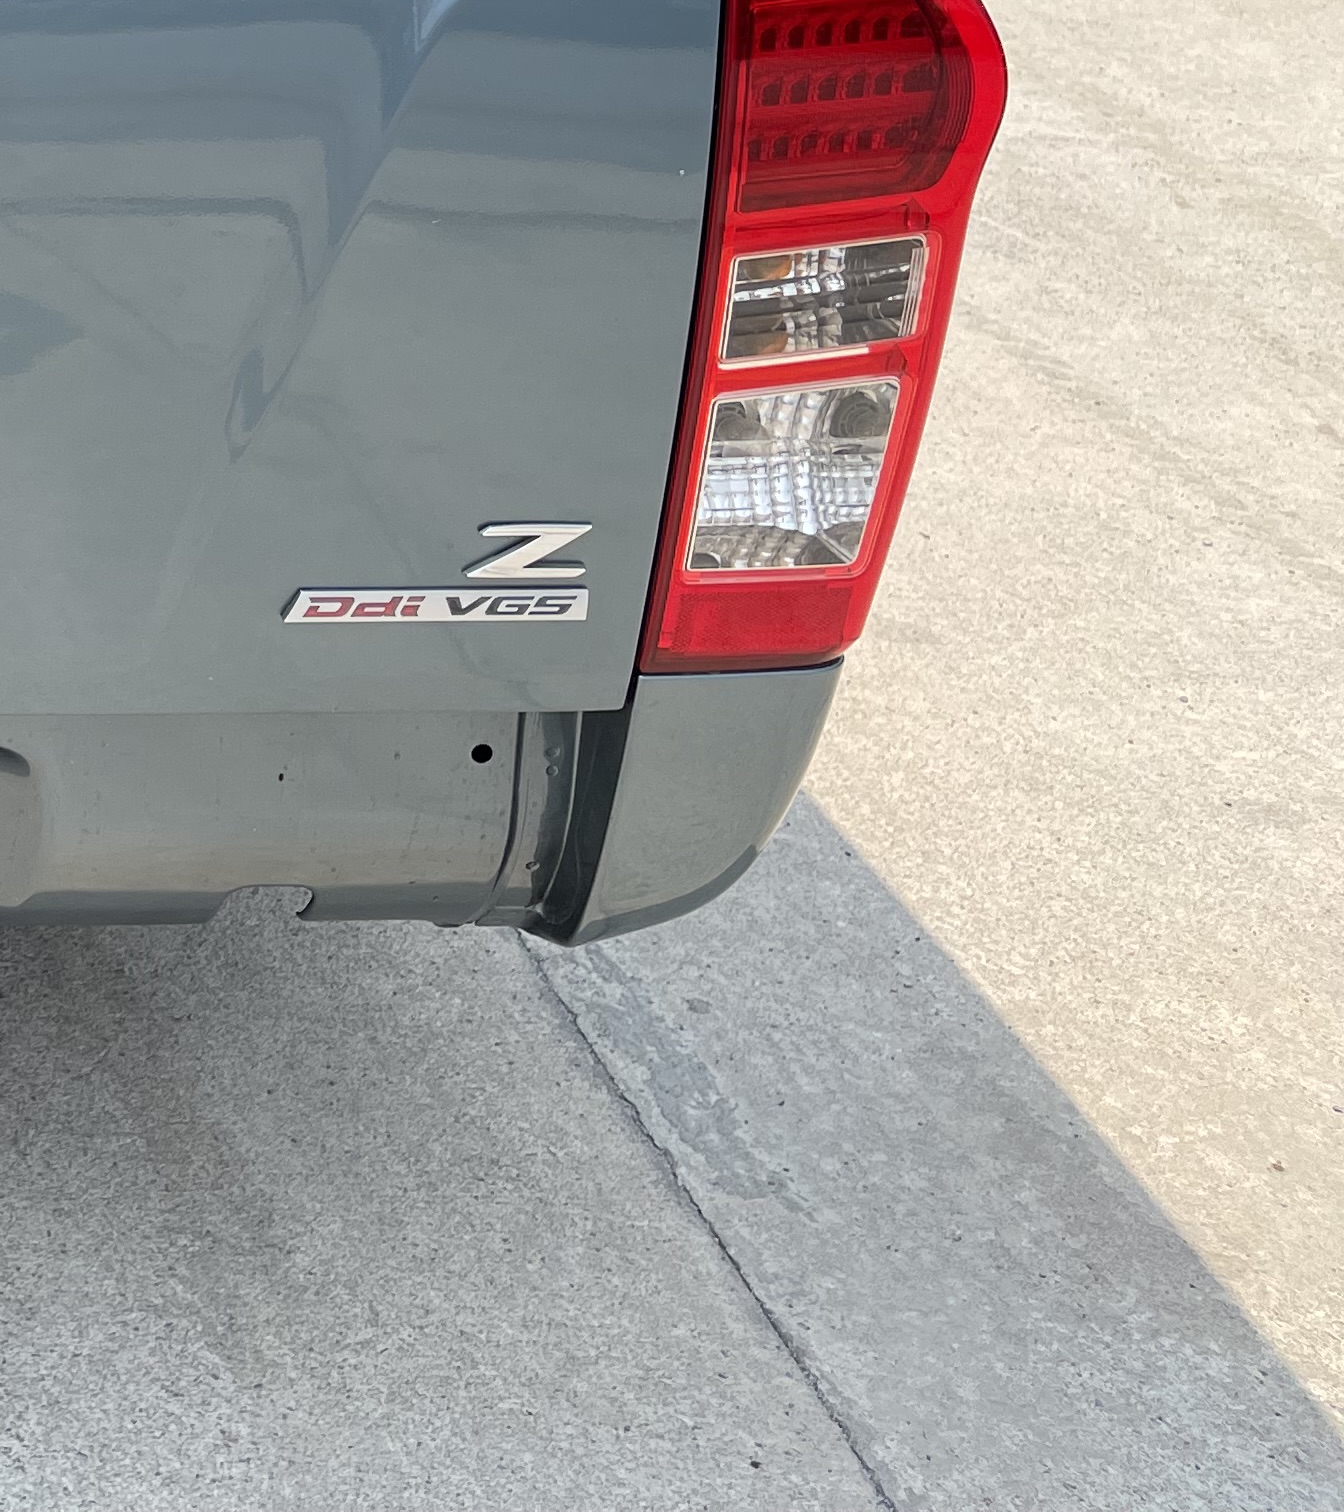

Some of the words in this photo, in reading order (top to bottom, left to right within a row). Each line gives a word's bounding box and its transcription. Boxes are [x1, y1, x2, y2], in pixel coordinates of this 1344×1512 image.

[461, 520, 594, 580] Z
[301, 595, 427, 618] Ddi
[444, 595, 579, 617] VGS
